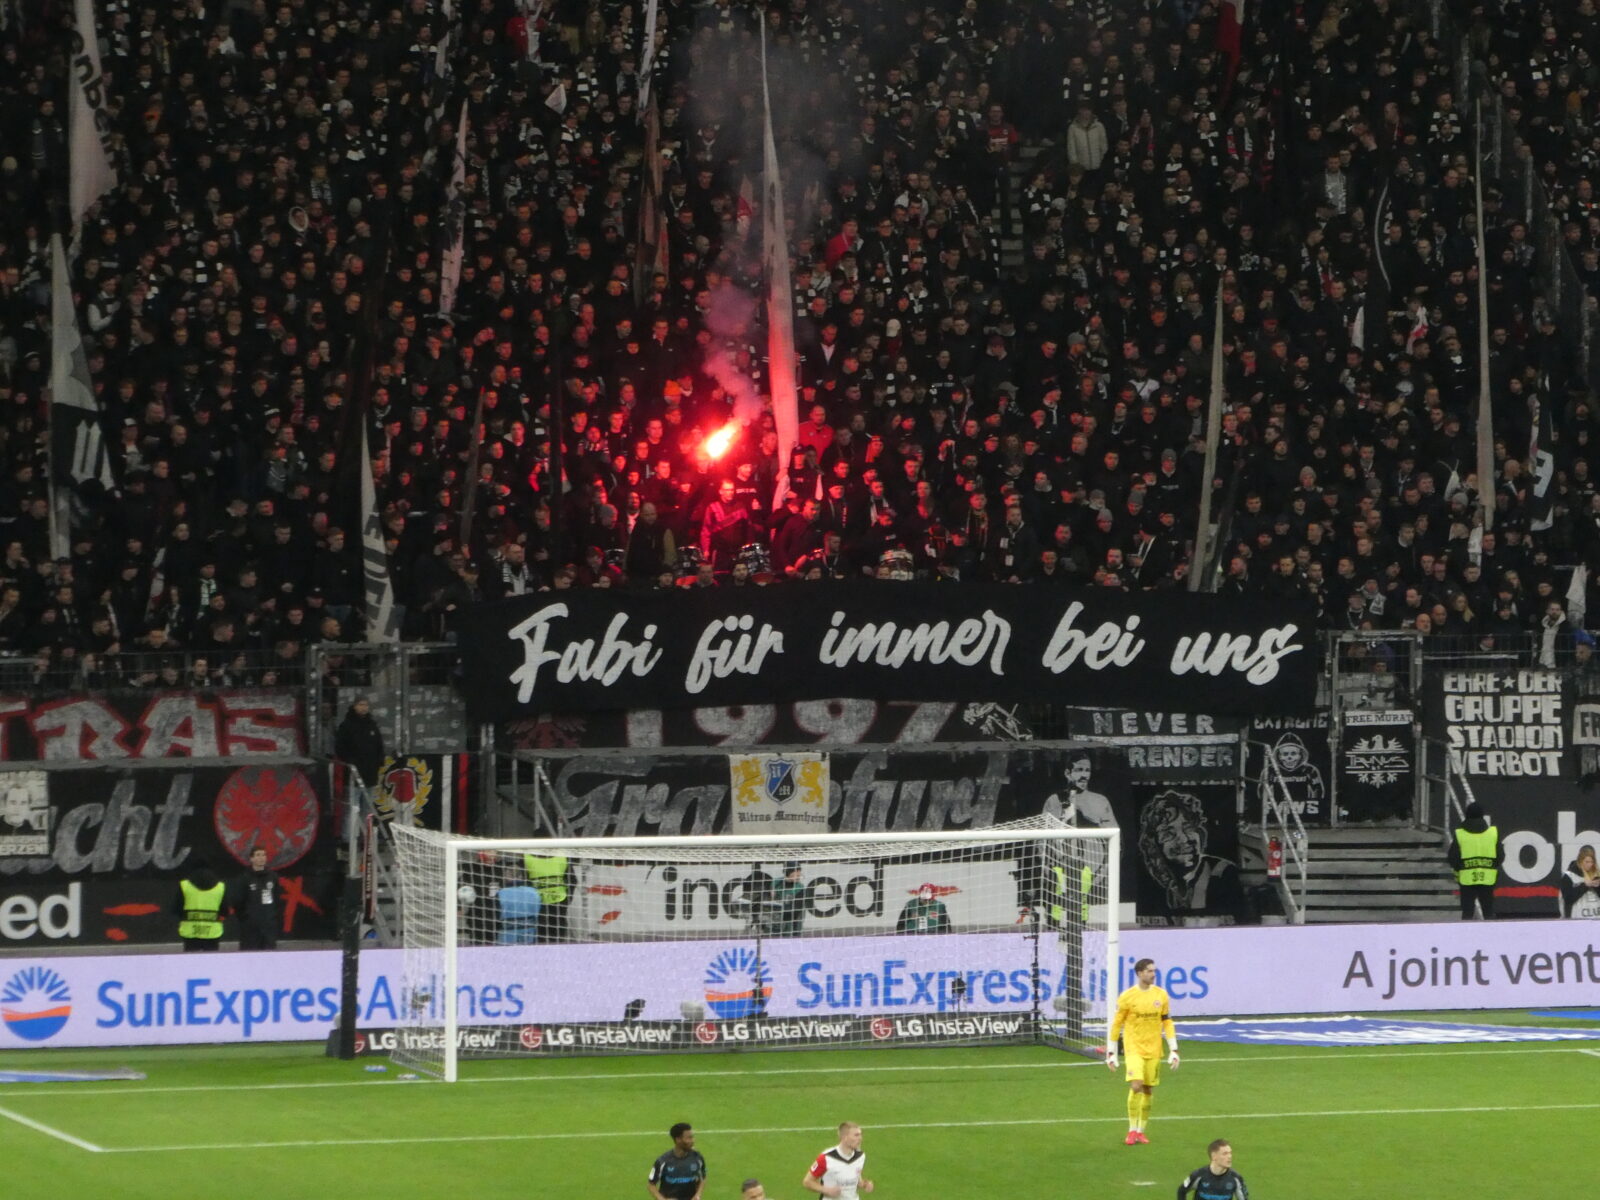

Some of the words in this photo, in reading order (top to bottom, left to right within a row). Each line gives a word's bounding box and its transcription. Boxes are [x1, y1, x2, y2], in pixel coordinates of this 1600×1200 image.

[508, 603, 663, 703] Fabi
[685, 614, 784, 694] für
[819, 611, 1011, 675] immer
[1042, 601, 1145, 674] bei
[1170, 623, 1303, 685] uns
[1443, 672, 1500, 693] EHRE
[1518, 670, 1562, 693] DER
[1346, 714, 1373, 724] FREE
[1375, 713, 1413, 722] MURAT
[1445, 695, 1562, 724] GRUPPE
[1092, 712, 1215, 734] NEVER
[1447, 725, 1563, 749] STADION
[1128, 746, 1233, 768] RENDER
[1450, 750, 1563, 776] VERBOT
[556, 752, 1010, 835] Frafurt
[662, 862, 884, 921] ined
[1342, 950, 1374, 988] A
[1382, 947, 1489, 1000] joint
[1501, 944, 1600, 984] vent
[547, 1029, 574, 1045] LG
[581, 1025, 674, 1043] InstaView
[722, 1024, 749, 1041] LG
[756, 1020, 847, 1039] InstaView
[897, 1020, 923, 1036] LG
[931, 1016, 1020, 1034] InstaView
[368, 1032, 397, 1050] LG
